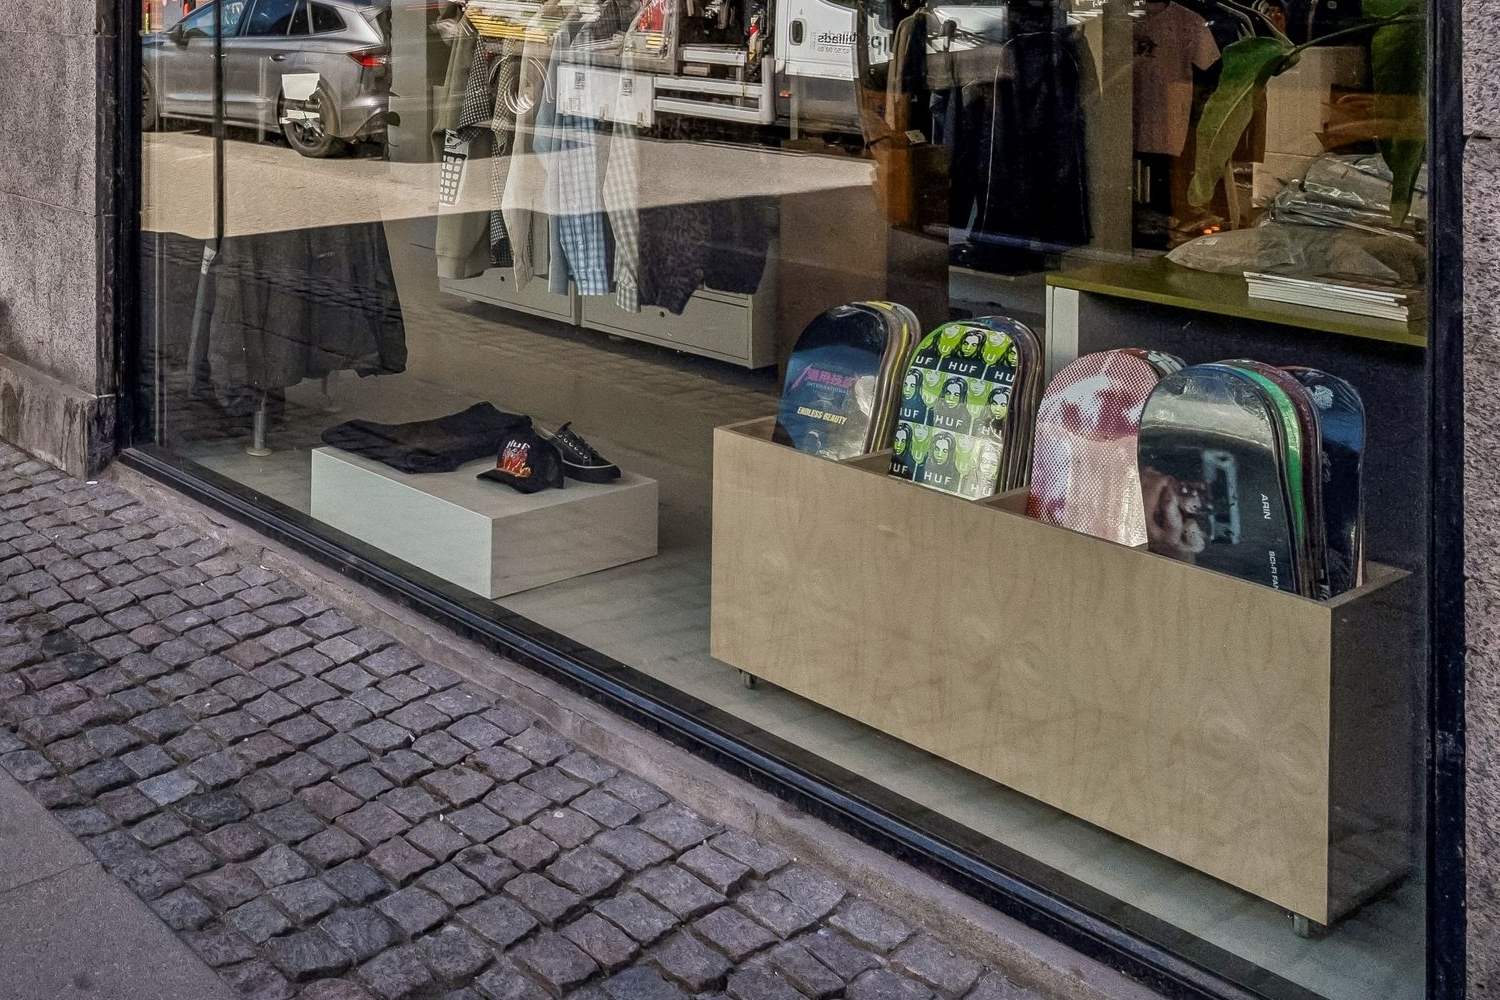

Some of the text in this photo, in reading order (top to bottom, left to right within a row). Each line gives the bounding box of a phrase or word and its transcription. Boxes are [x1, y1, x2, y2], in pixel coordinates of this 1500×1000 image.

[948, 361, 978, 373] HUF
[797, 406, 848, 425] ENDLESS BEAUTY
[935, 415, 963, 429] HUF
[924, 472, 951, 485] HUF
[1260, 493, 1272, 520] ARIN
[1268, 550, 1278, 573] SCI-FI
